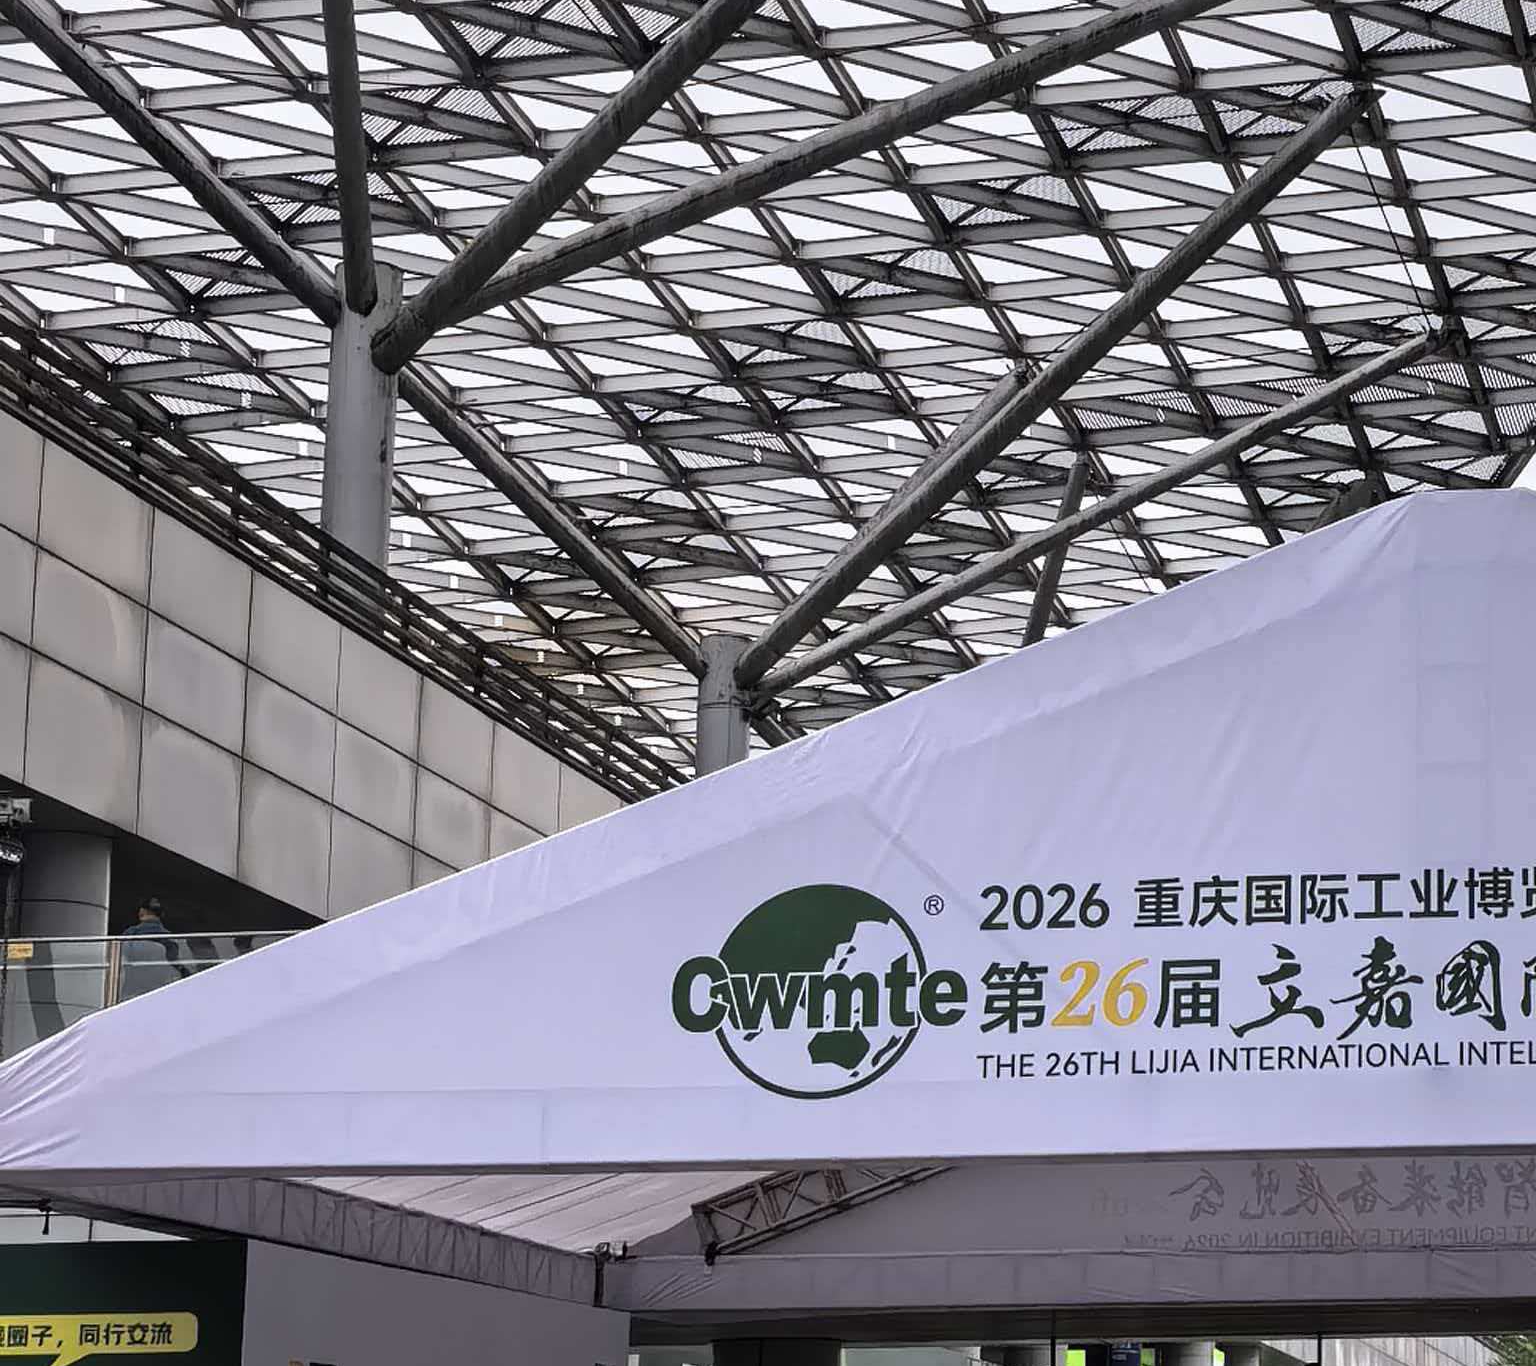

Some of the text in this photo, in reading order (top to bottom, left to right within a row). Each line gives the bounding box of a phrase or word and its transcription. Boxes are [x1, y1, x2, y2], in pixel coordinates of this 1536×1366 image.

[979, 882, 1110, 931] 2026
[671, 952, 968, 1033] Cwmte
[976, 1053, 1035, 1079] THE
[1046, 1050, 1119, 1077] 26TH
[1130, 1046, 1200, 1074] LIJIA
[1209, 1041, 1449, 1072] INTERNATIONAL
